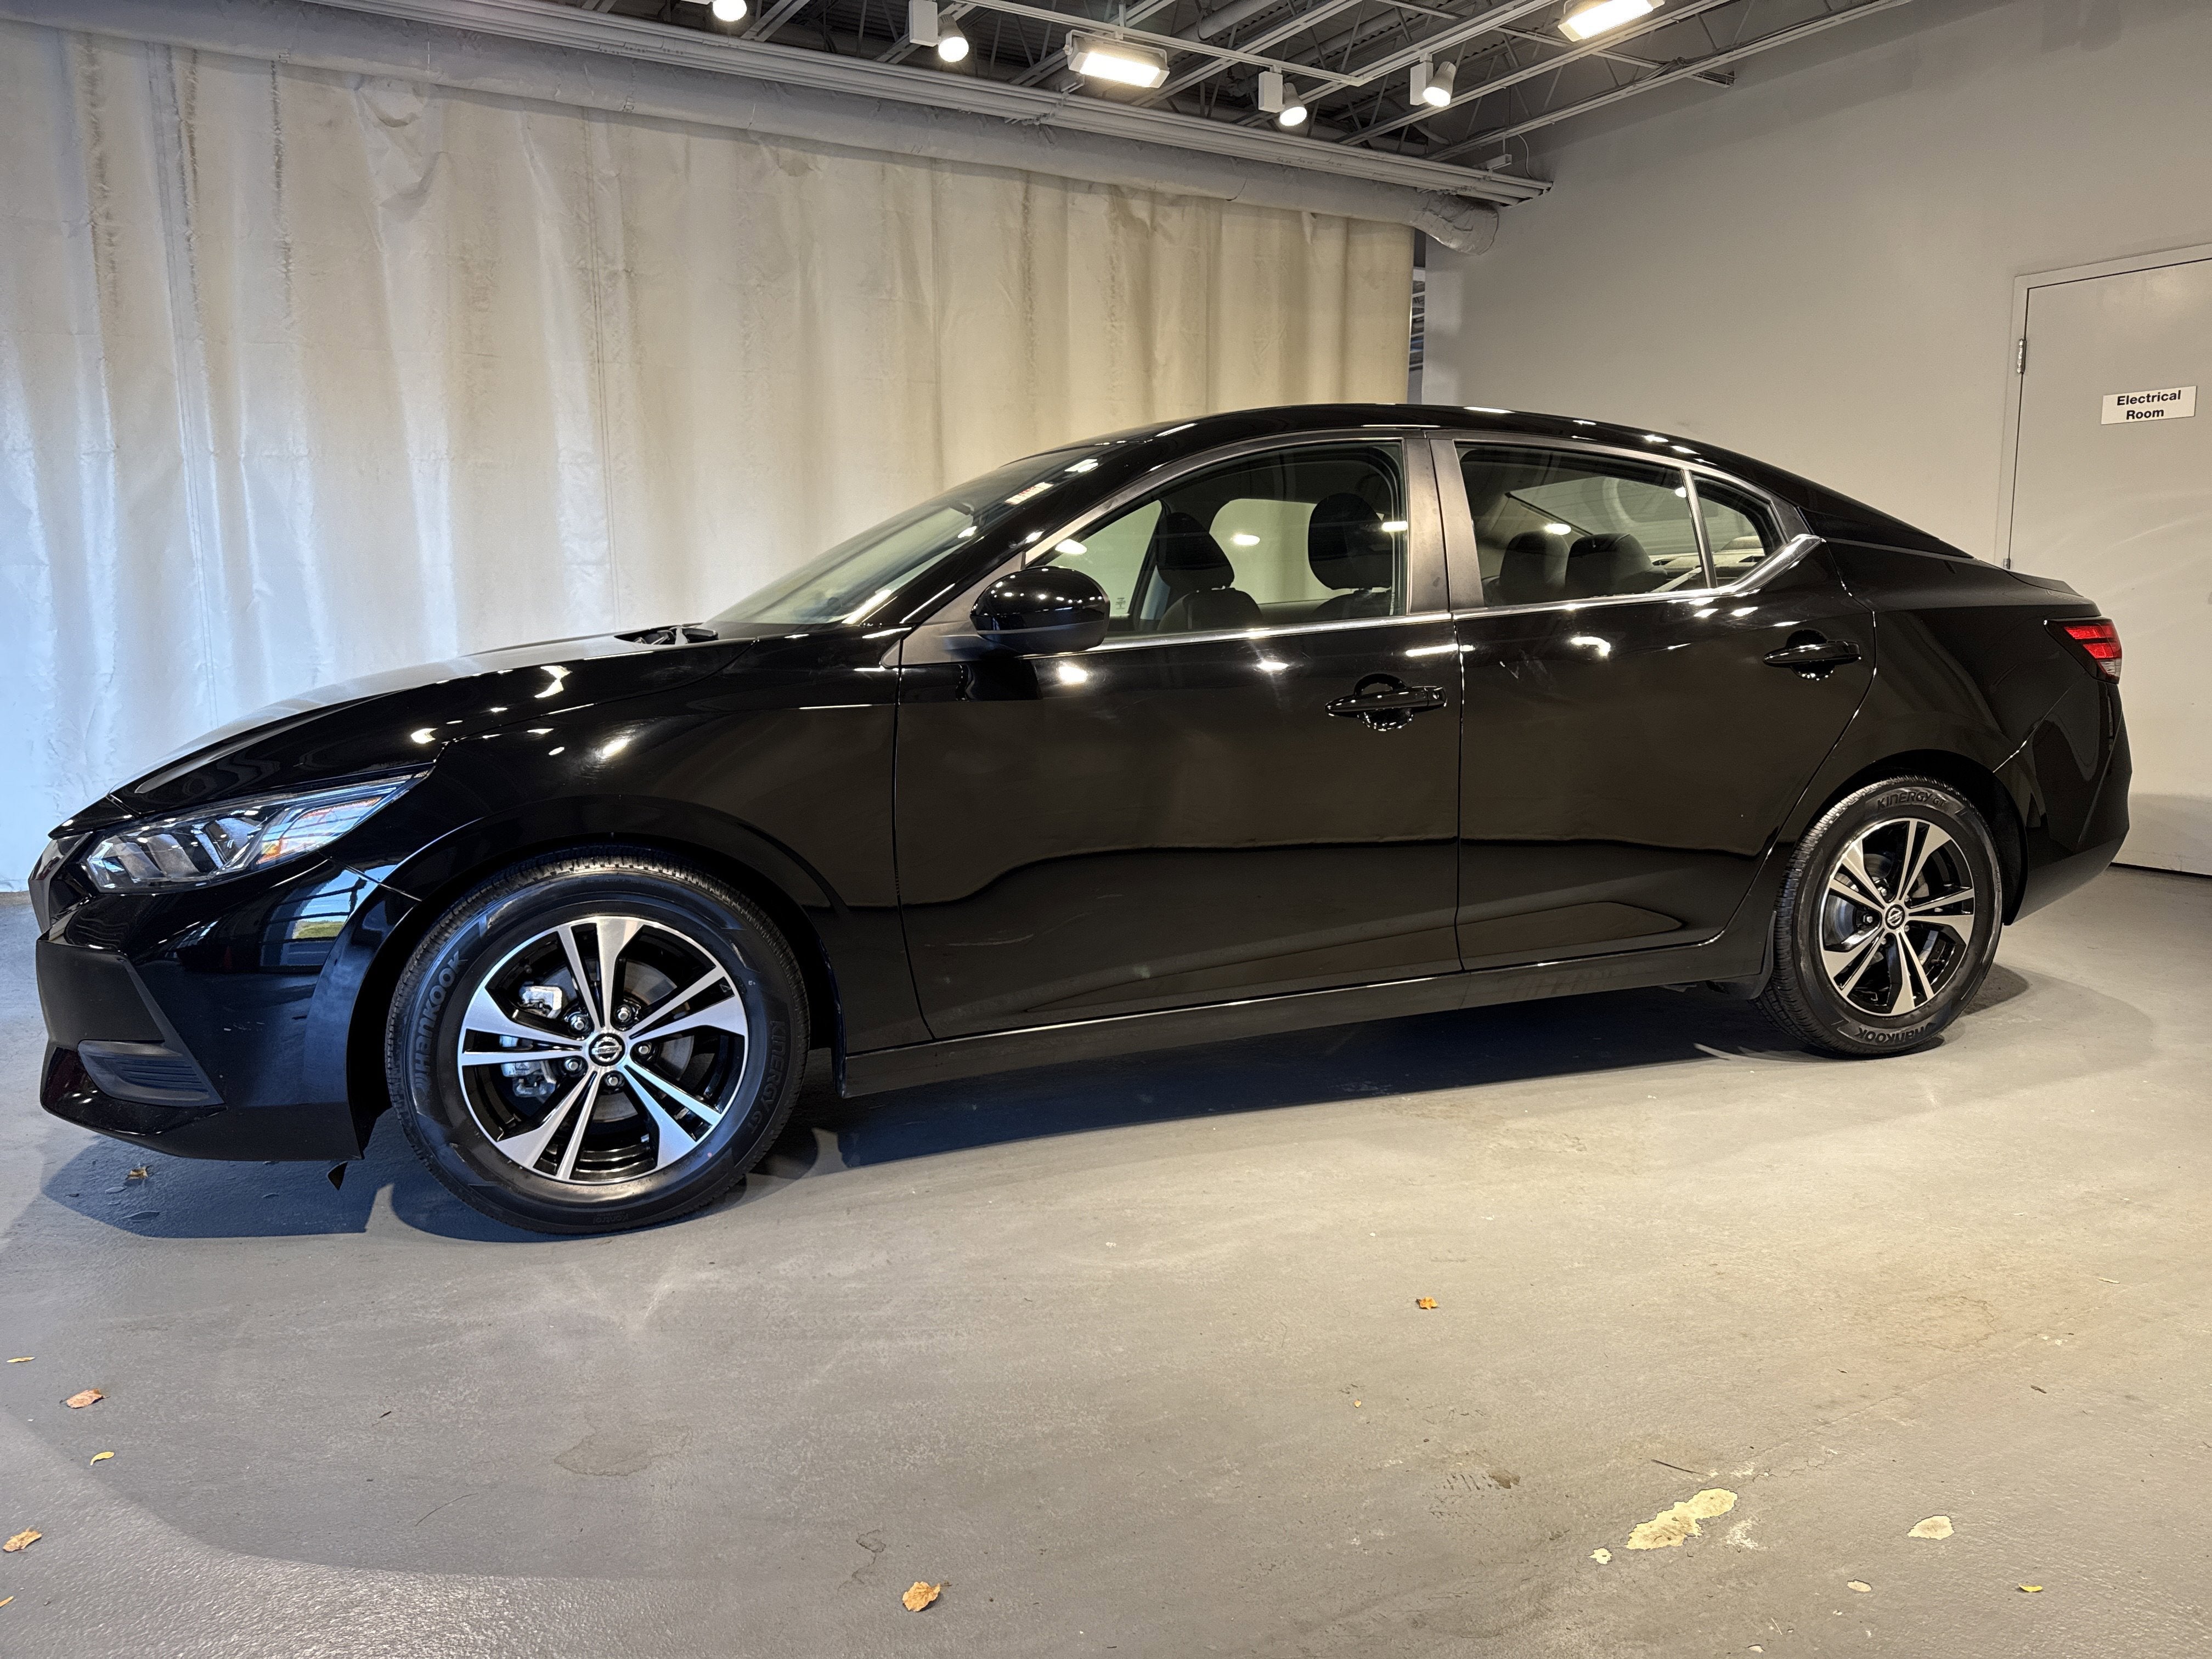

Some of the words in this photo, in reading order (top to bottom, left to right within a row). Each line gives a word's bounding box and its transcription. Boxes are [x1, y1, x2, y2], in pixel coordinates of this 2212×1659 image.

[2117, 390, 2181, 405] Electrical
[2126, 409, 2164, 420] Room
[1933, 797, 1946, 807] GT
